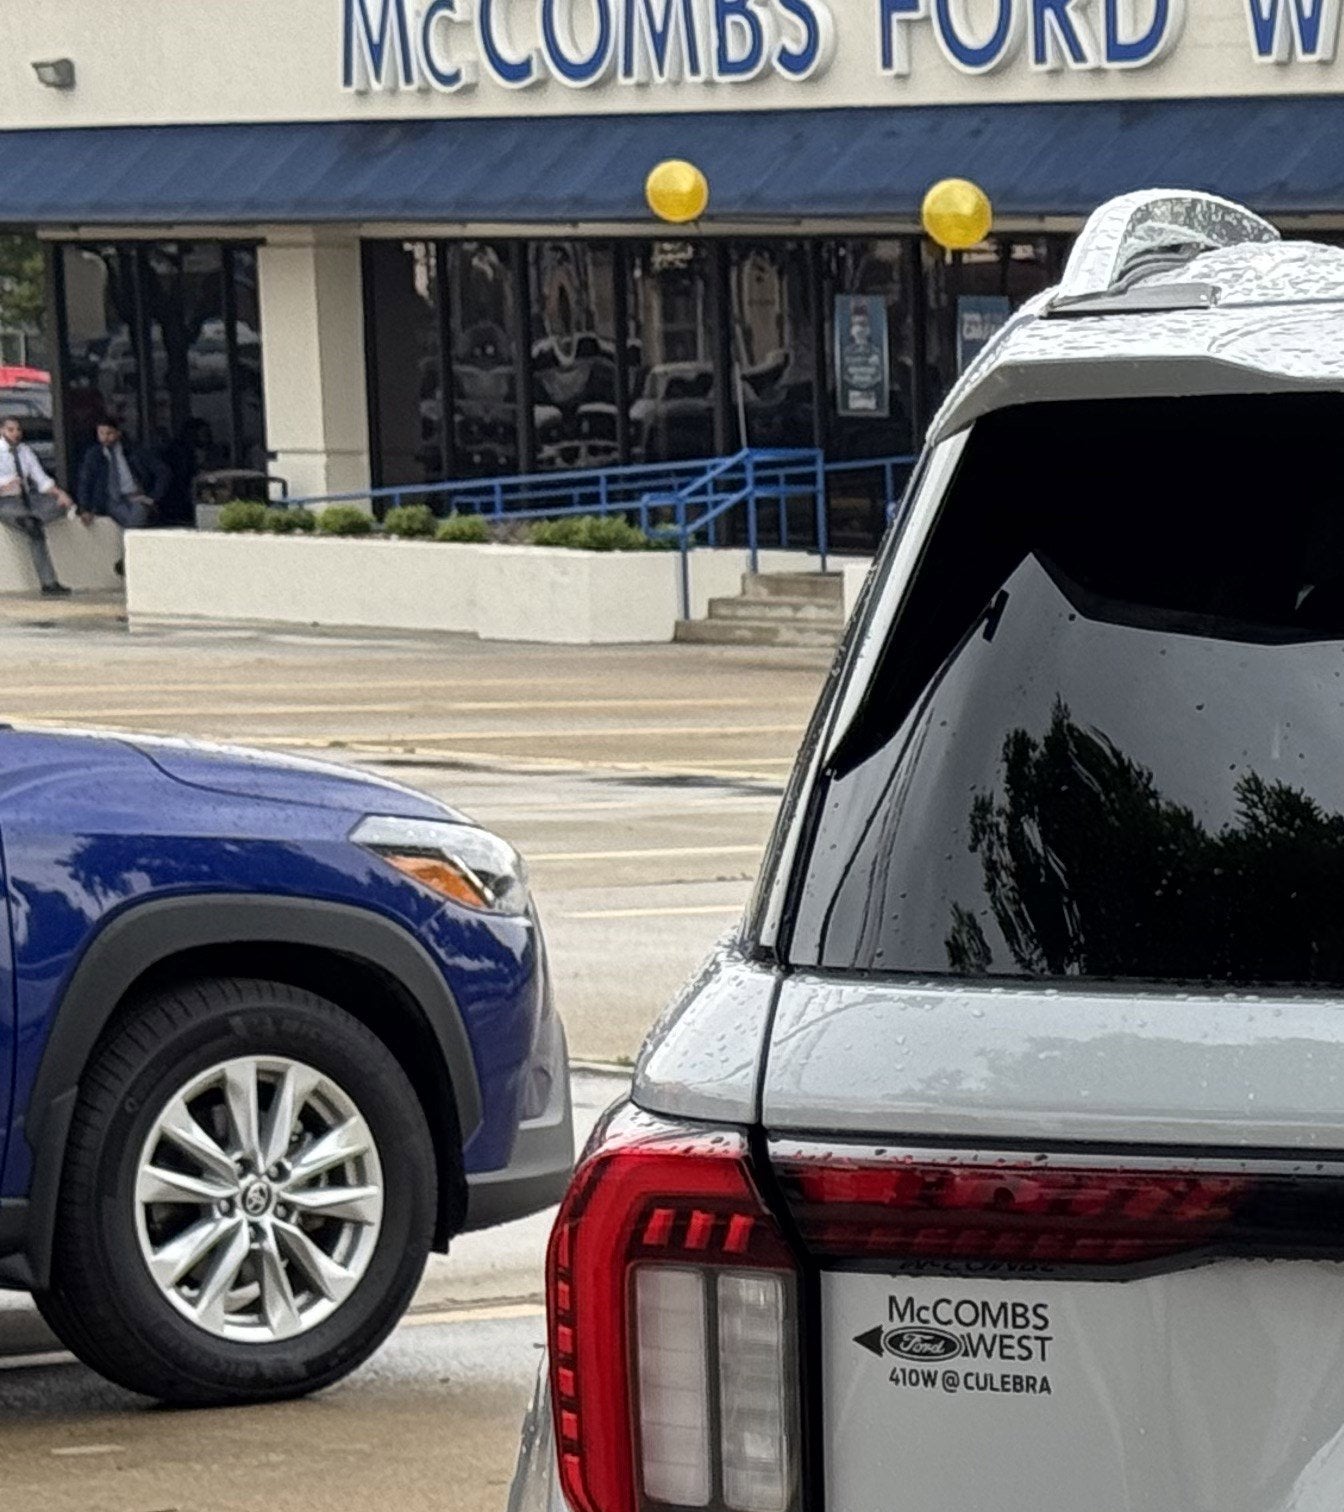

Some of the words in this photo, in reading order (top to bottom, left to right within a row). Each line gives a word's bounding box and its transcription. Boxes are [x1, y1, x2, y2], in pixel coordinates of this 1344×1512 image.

[340, 0, 834, 93] McCOMBS
[888, 1295, 1050, 1331] McCOMBS
[965, 1333, 1053, 1362] WEST
[888, 1367, 938, 1389] 410W
[963, 1372, 1052, 1395] CULEBRA
